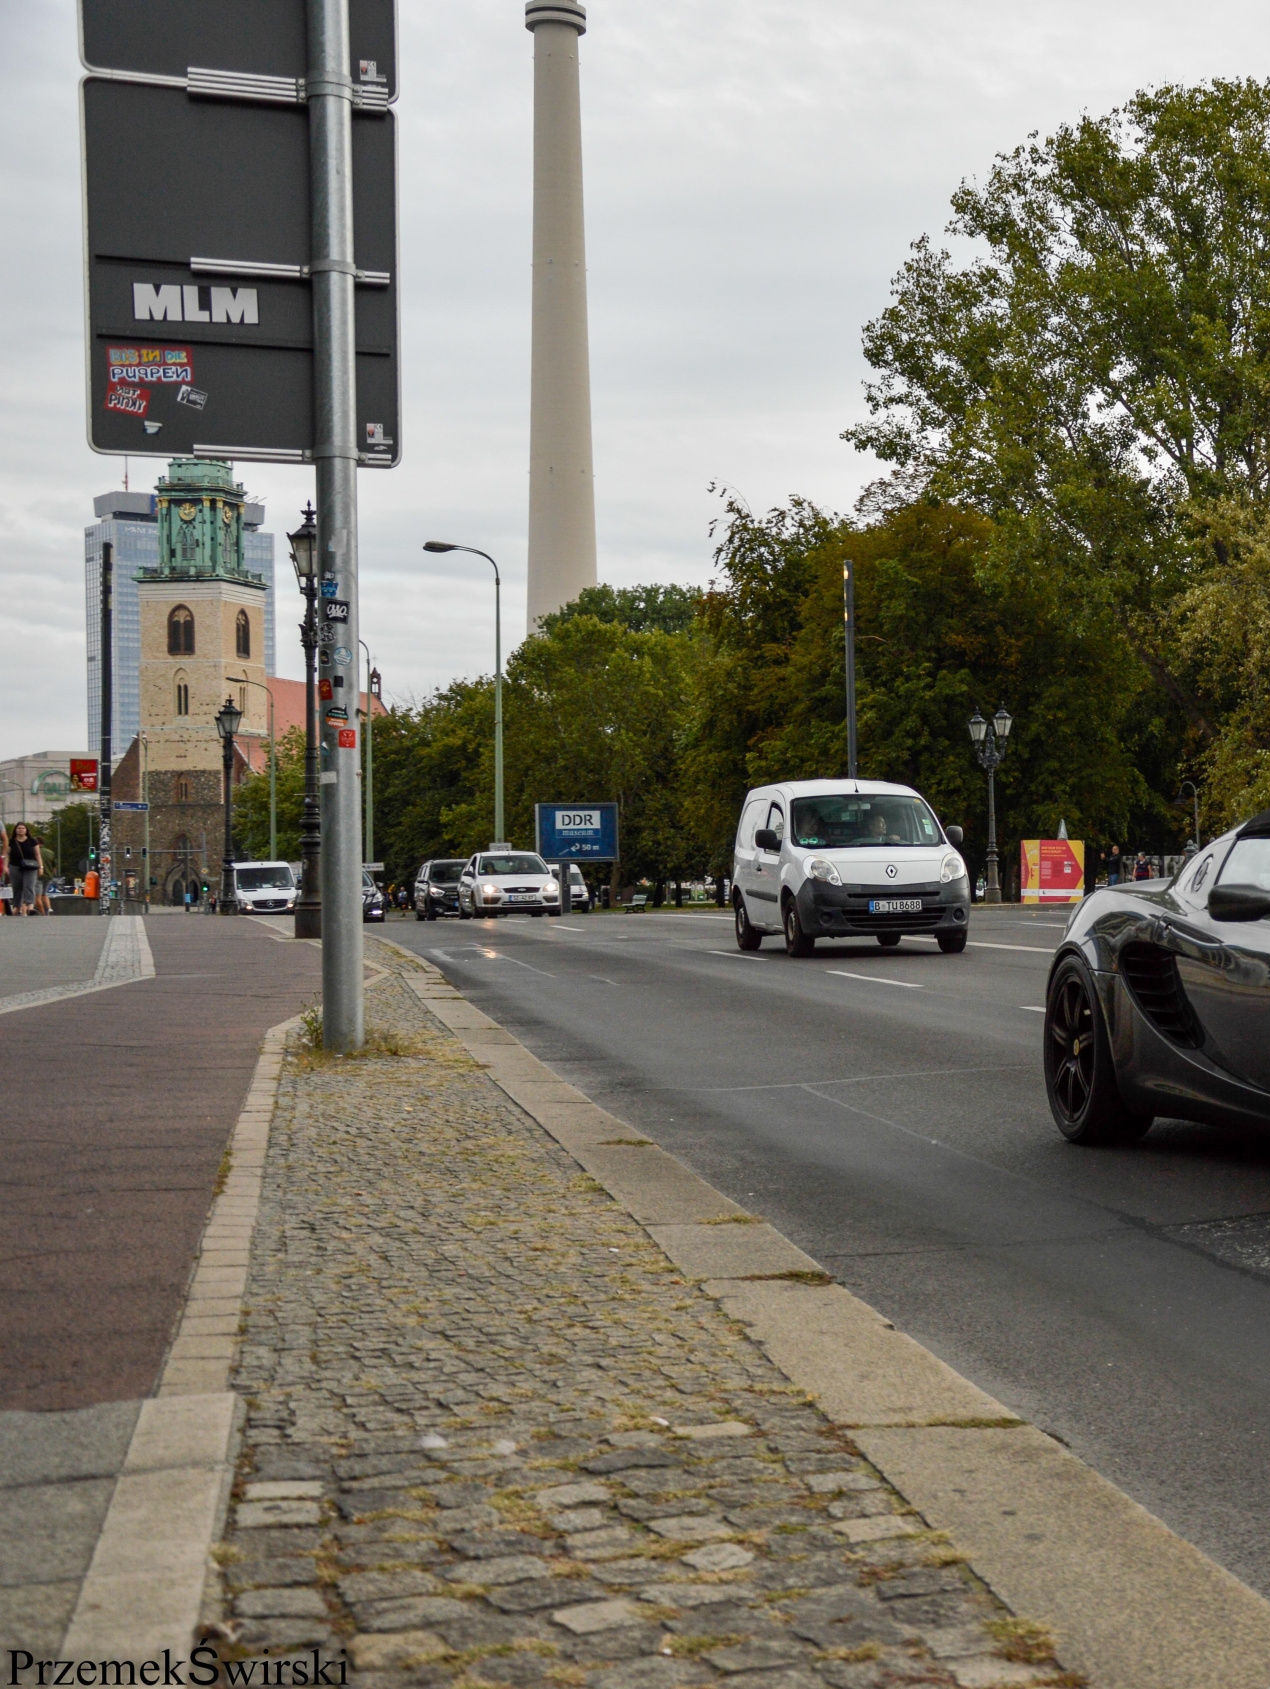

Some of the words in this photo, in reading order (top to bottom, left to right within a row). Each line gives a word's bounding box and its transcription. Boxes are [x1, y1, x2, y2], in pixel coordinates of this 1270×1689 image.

[133, 283, 259, 324] MLM
[110, 349, 139, 365] BIS
[141, 349, 162, 365] IN
[165, 350, 188, 363] DIE
[562, 814, 594, 826] DDR
[875, 902, 880, 910] B
